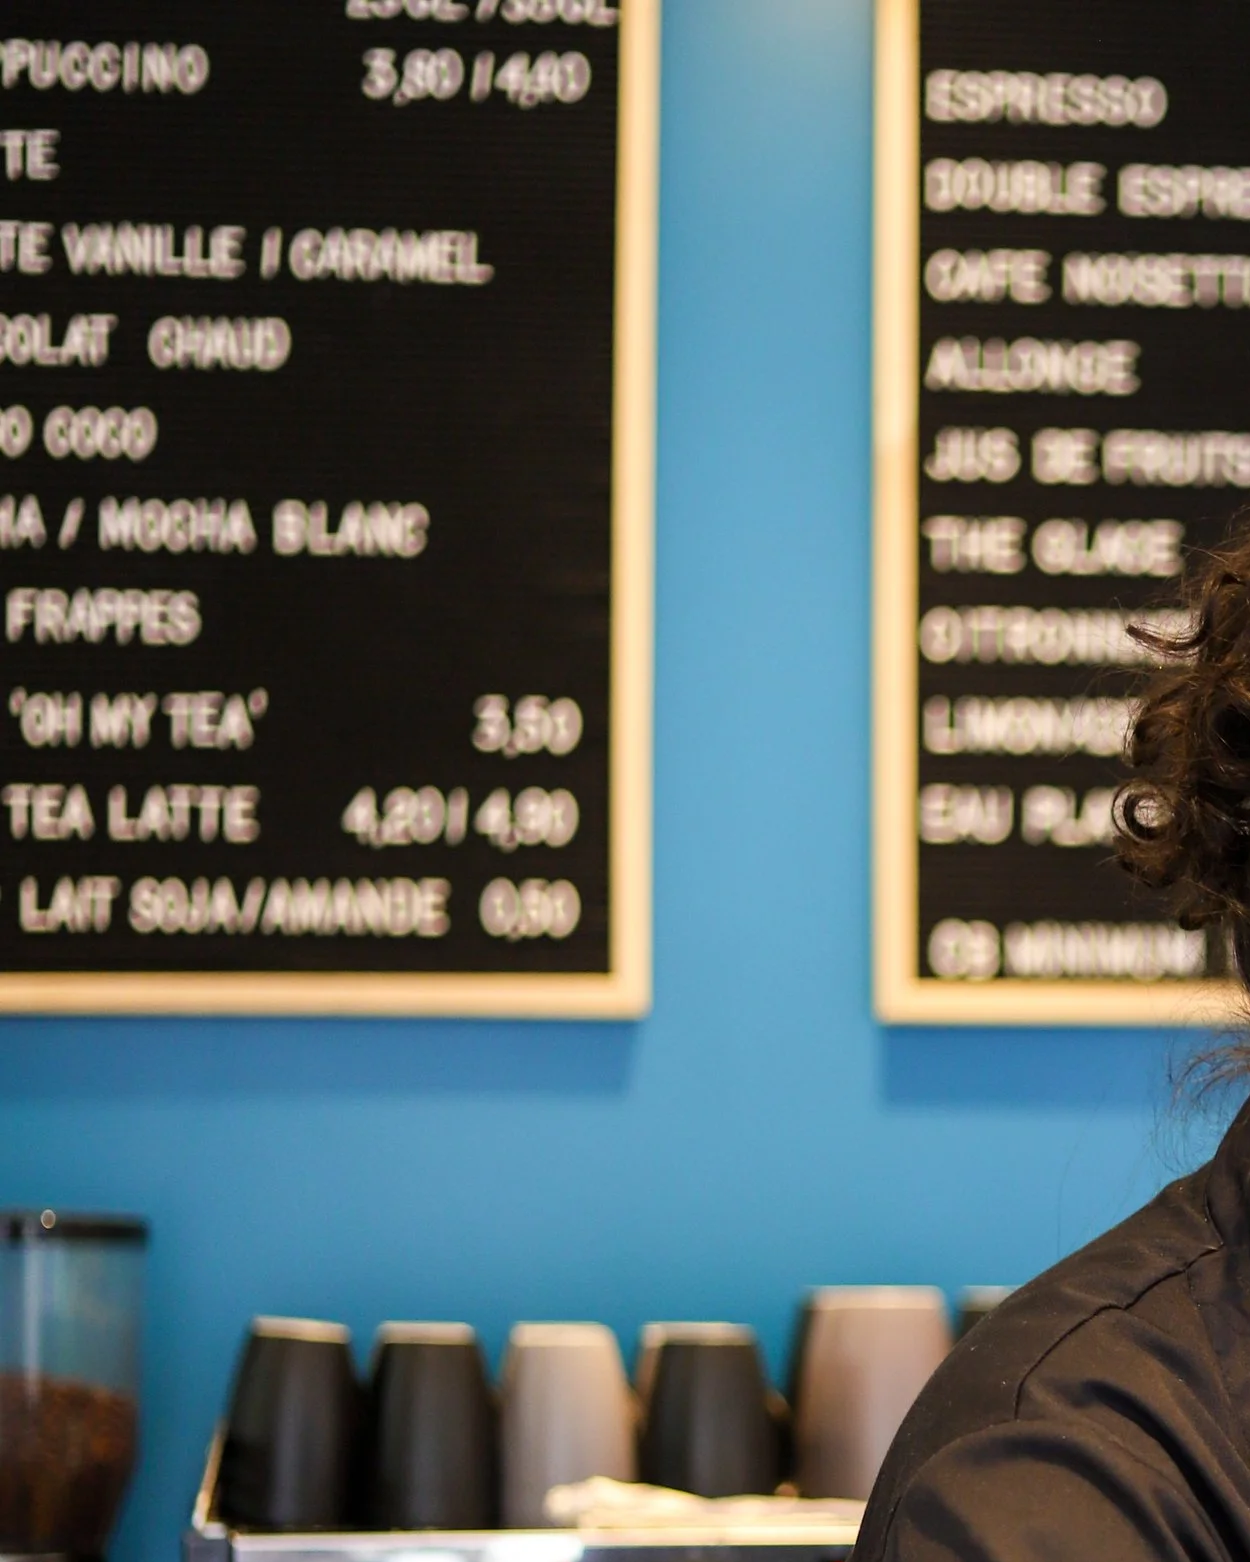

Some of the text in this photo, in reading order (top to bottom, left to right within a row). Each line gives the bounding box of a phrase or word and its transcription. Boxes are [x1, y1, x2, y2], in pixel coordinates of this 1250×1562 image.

[0, 39, 208, 93] PUCCINO
[925, 69, 1167, 127] ESPRESSO
[924, 158, 1105, 215] DOUBLE
[62, 223, 244, 278] VANILLE
[289, 228, 493, 284] CARAMEL
[924, 249, 1050, 304] CAFE
[148, 317, 291, 370] CHAUD
[925, 338, 1139, 395] ALLONGE
[43, 406, 157, 460] COCO
[924, 428, 1021, 483] JUS
[1032, 428, 1098, 484] DE
[99, 497, 256, 552] MOCHA
[273, 500, 429, 557] BLANC
[923, 516, 1183, 577] THE GLACE
[6, 588, 201, 645] FRAPPES
[90, 694, 156, 746] MY
[473, 695, 582, 756] 3,50
[923, 696, 1140, 756] LIMONAD
[4, 784, 94, 839] TEA
[108, 785, 257, 842] LATTE
[919, 784, 1014, 844] EAU
[20, 876, 118, 931] LAIT
[129, 878, 449, 936] SOJA/AMANDE
